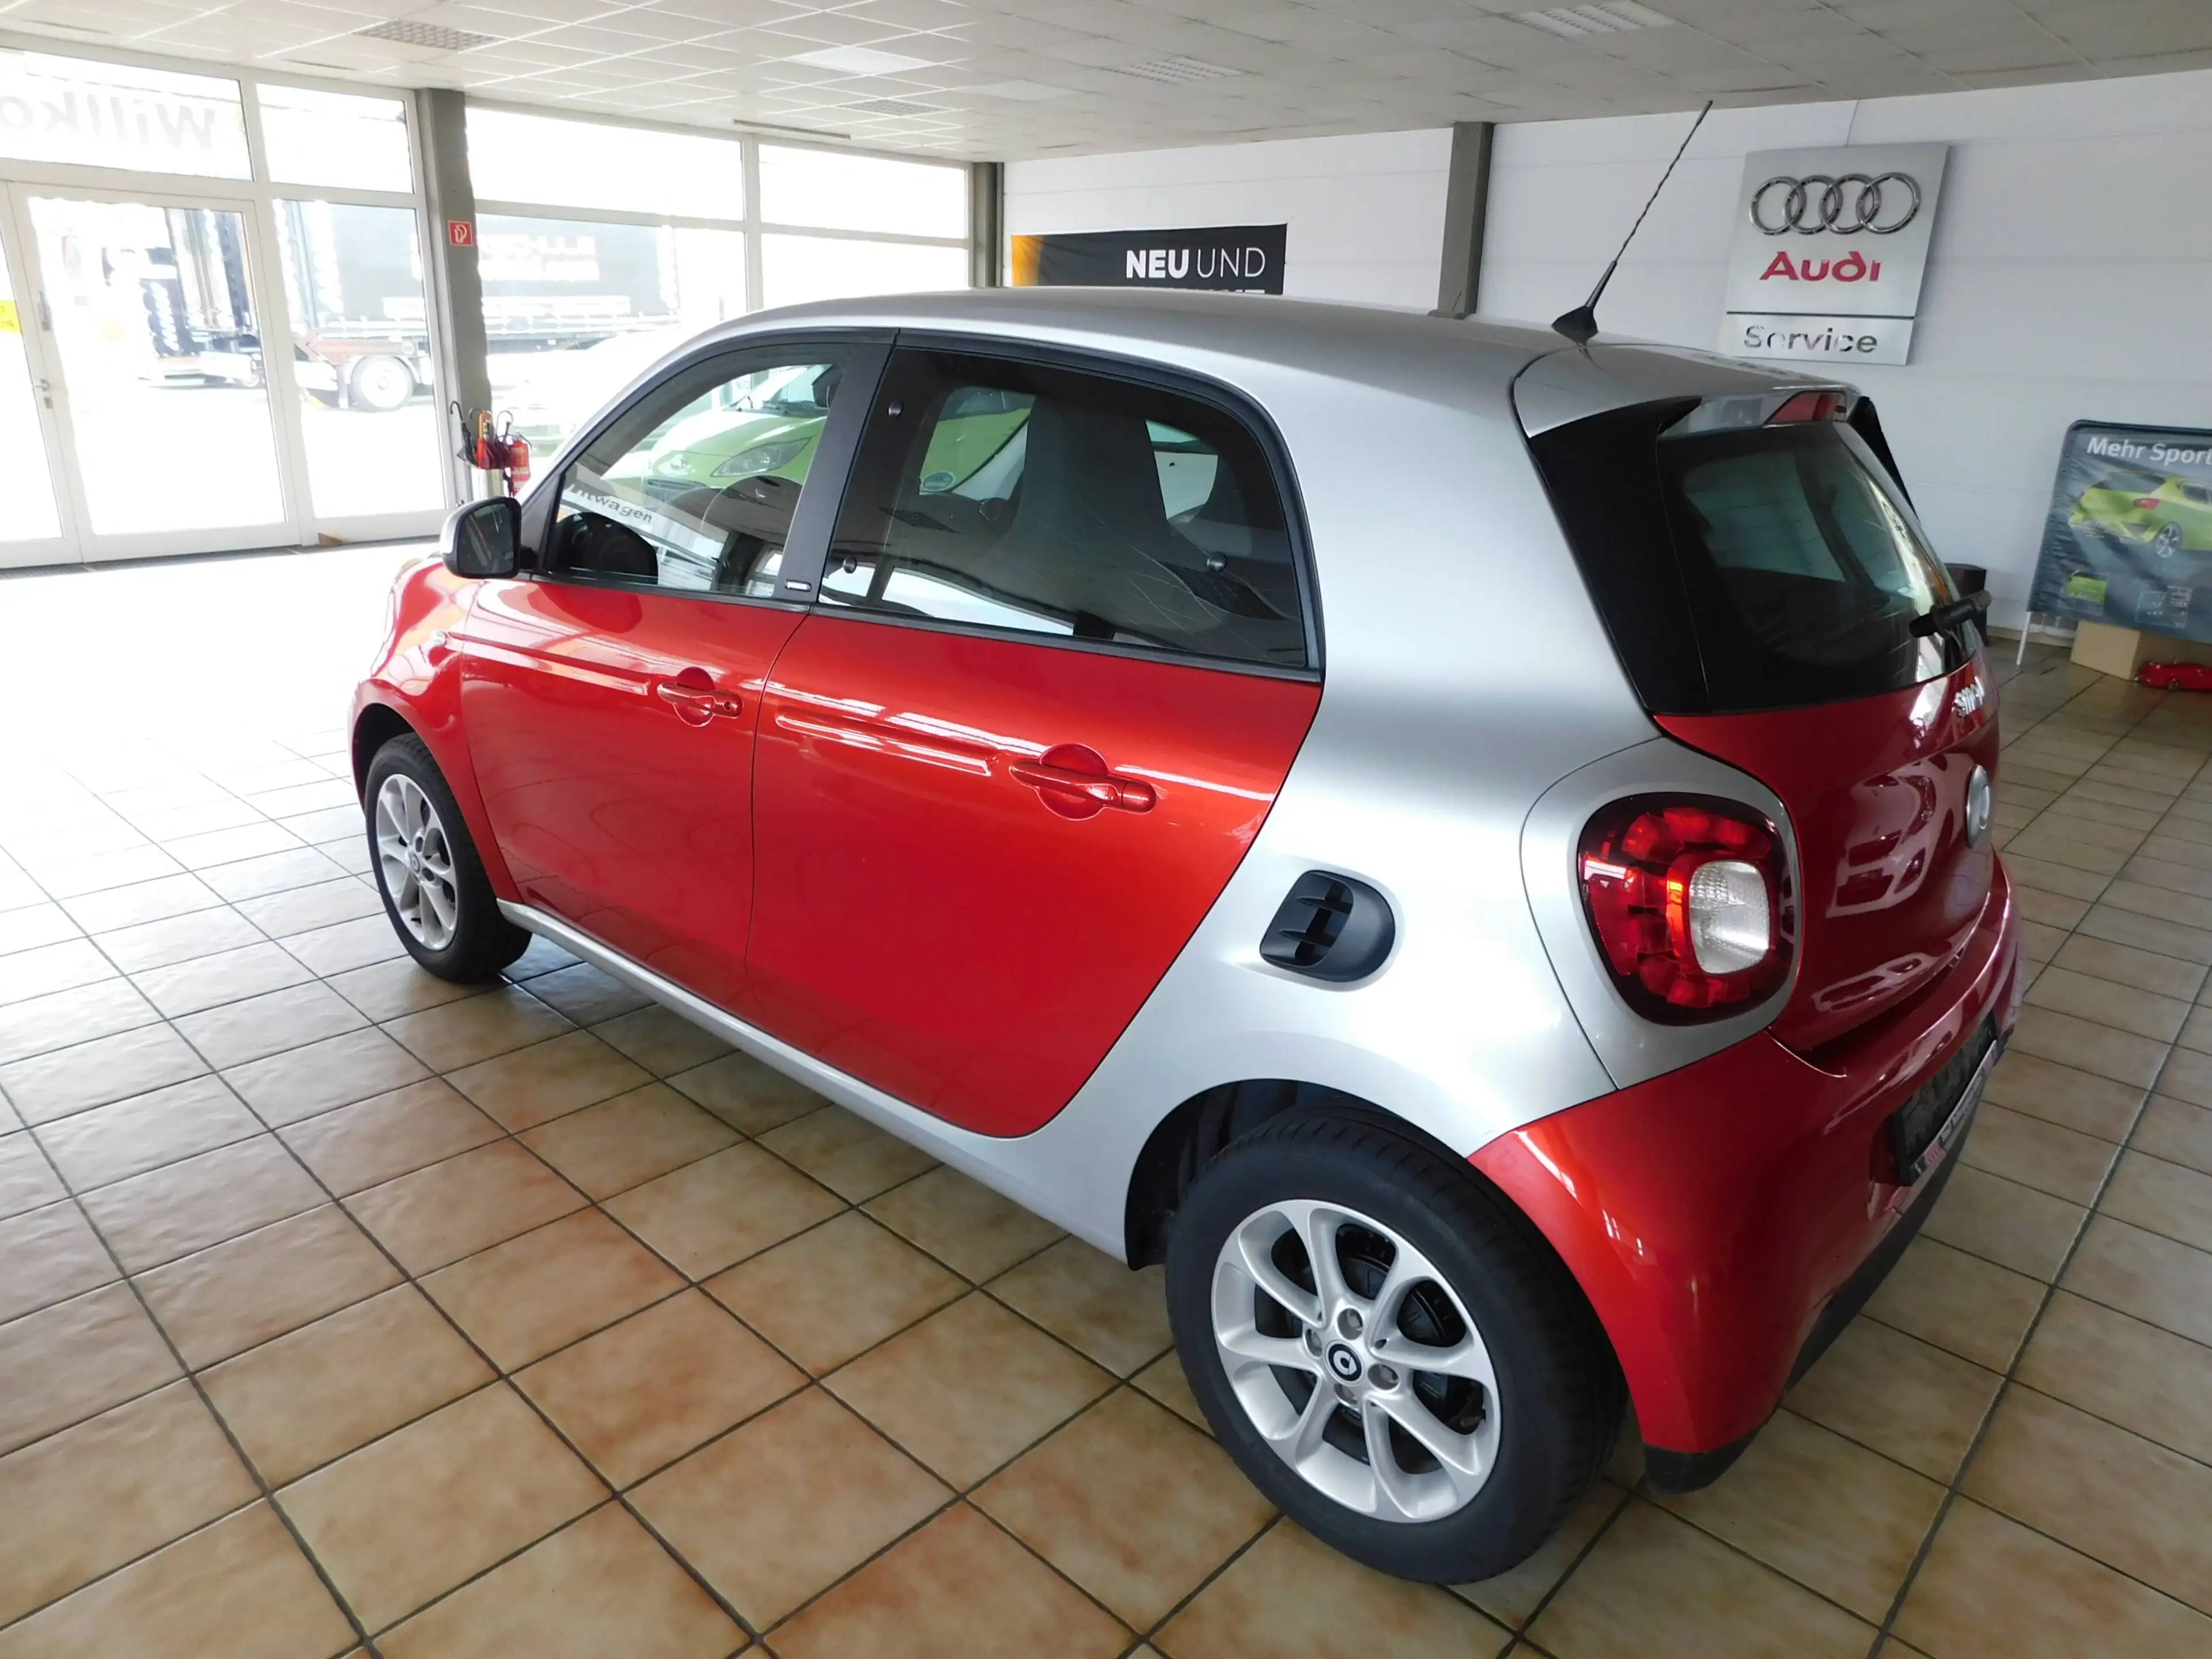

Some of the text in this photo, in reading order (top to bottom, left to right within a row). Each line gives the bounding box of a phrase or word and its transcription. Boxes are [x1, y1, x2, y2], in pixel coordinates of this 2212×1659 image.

[1126, 247, 1266, 279] NEU UND
[1759, 251, 1881, 282] Audi
[2086, 436, 2146, 459] Mehr
